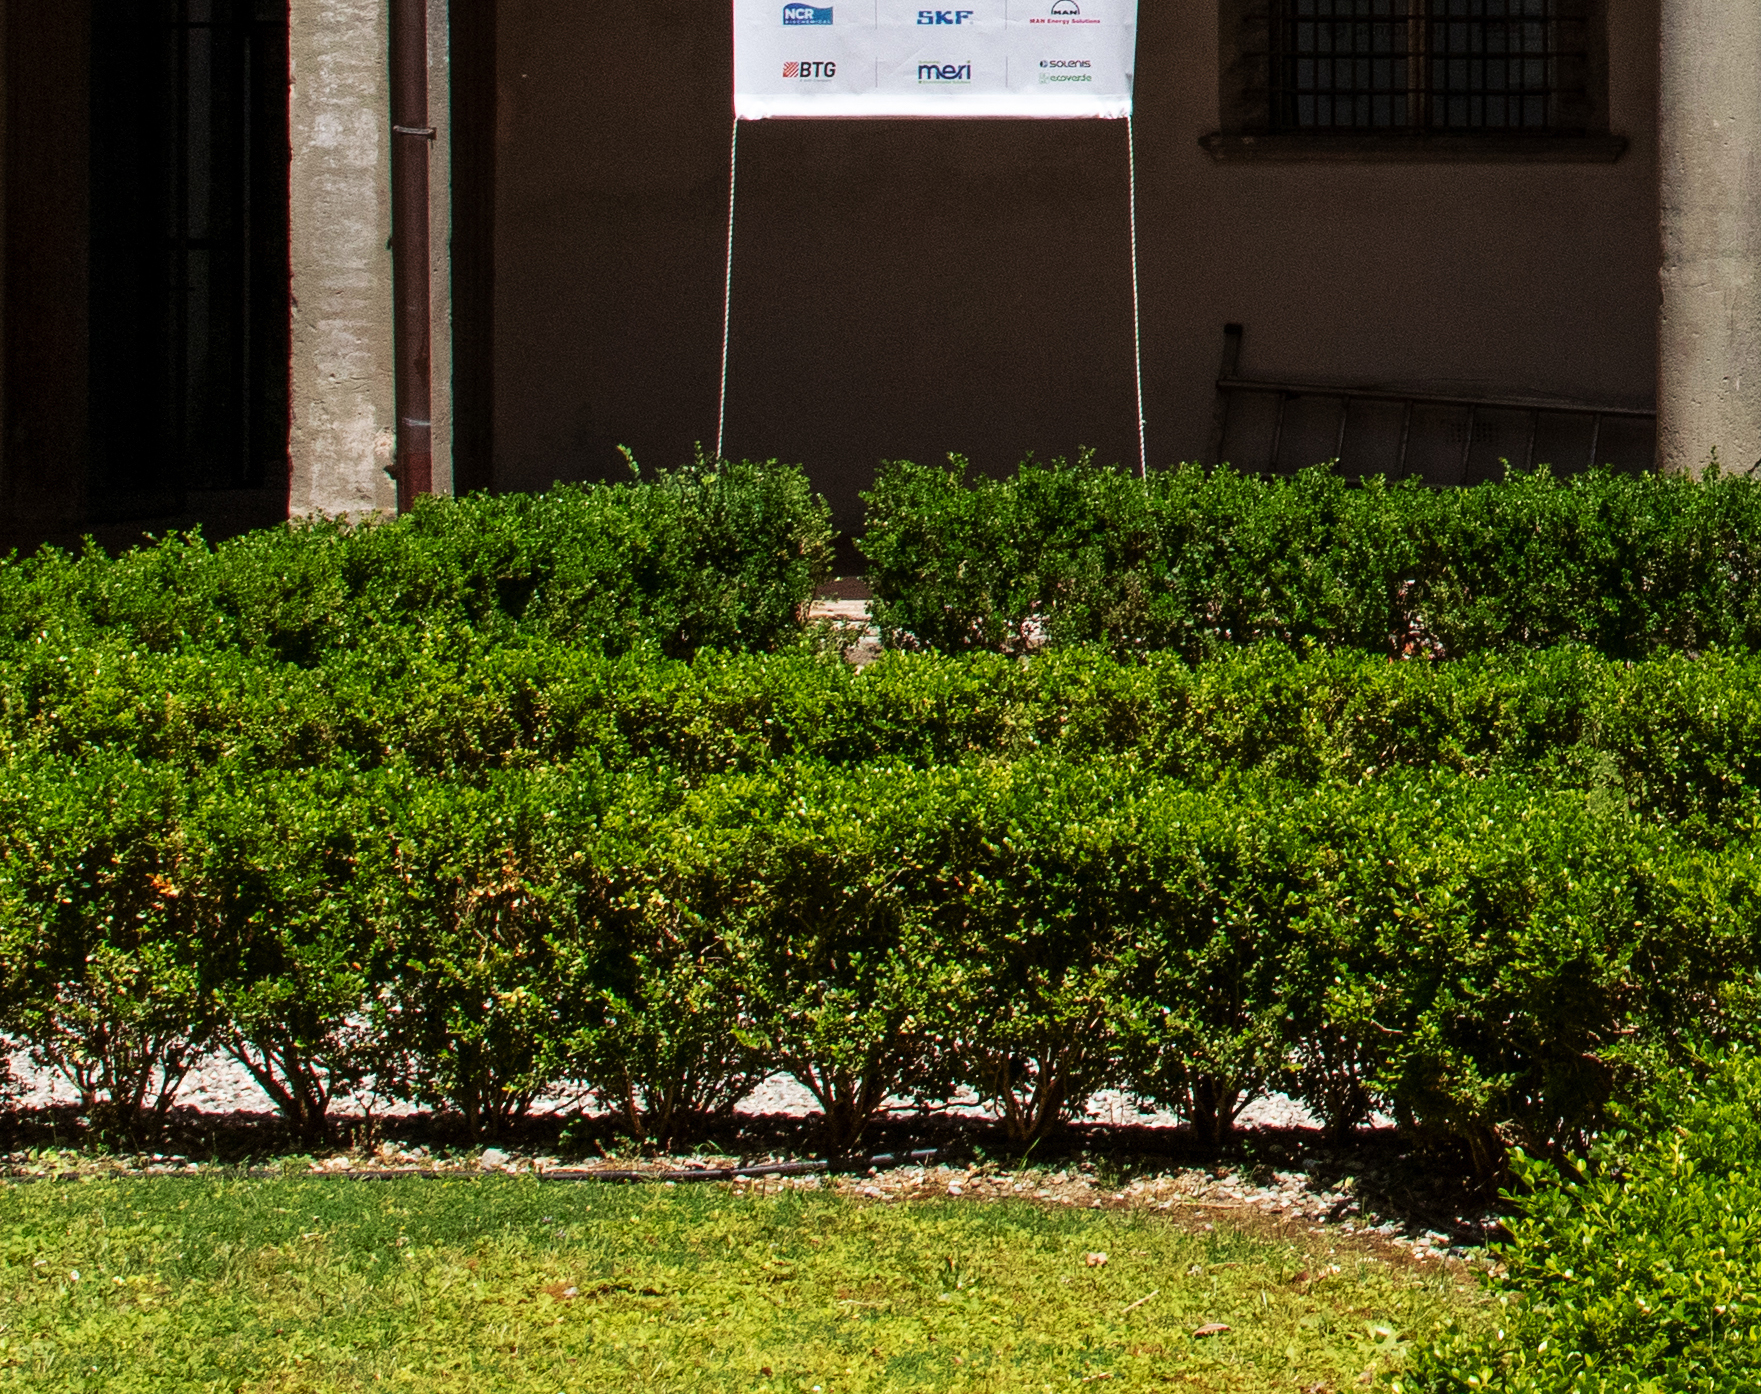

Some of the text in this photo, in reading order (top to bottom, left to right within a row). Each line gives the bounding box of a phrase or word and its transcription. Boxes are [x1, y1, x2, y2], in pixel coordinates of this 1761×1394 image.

[785, 8, 814, 19] NCR
[917, 10, 974, 25] SKF
[800, 61, 836, 78] BTG
[918, 60, 971, 80] meri
